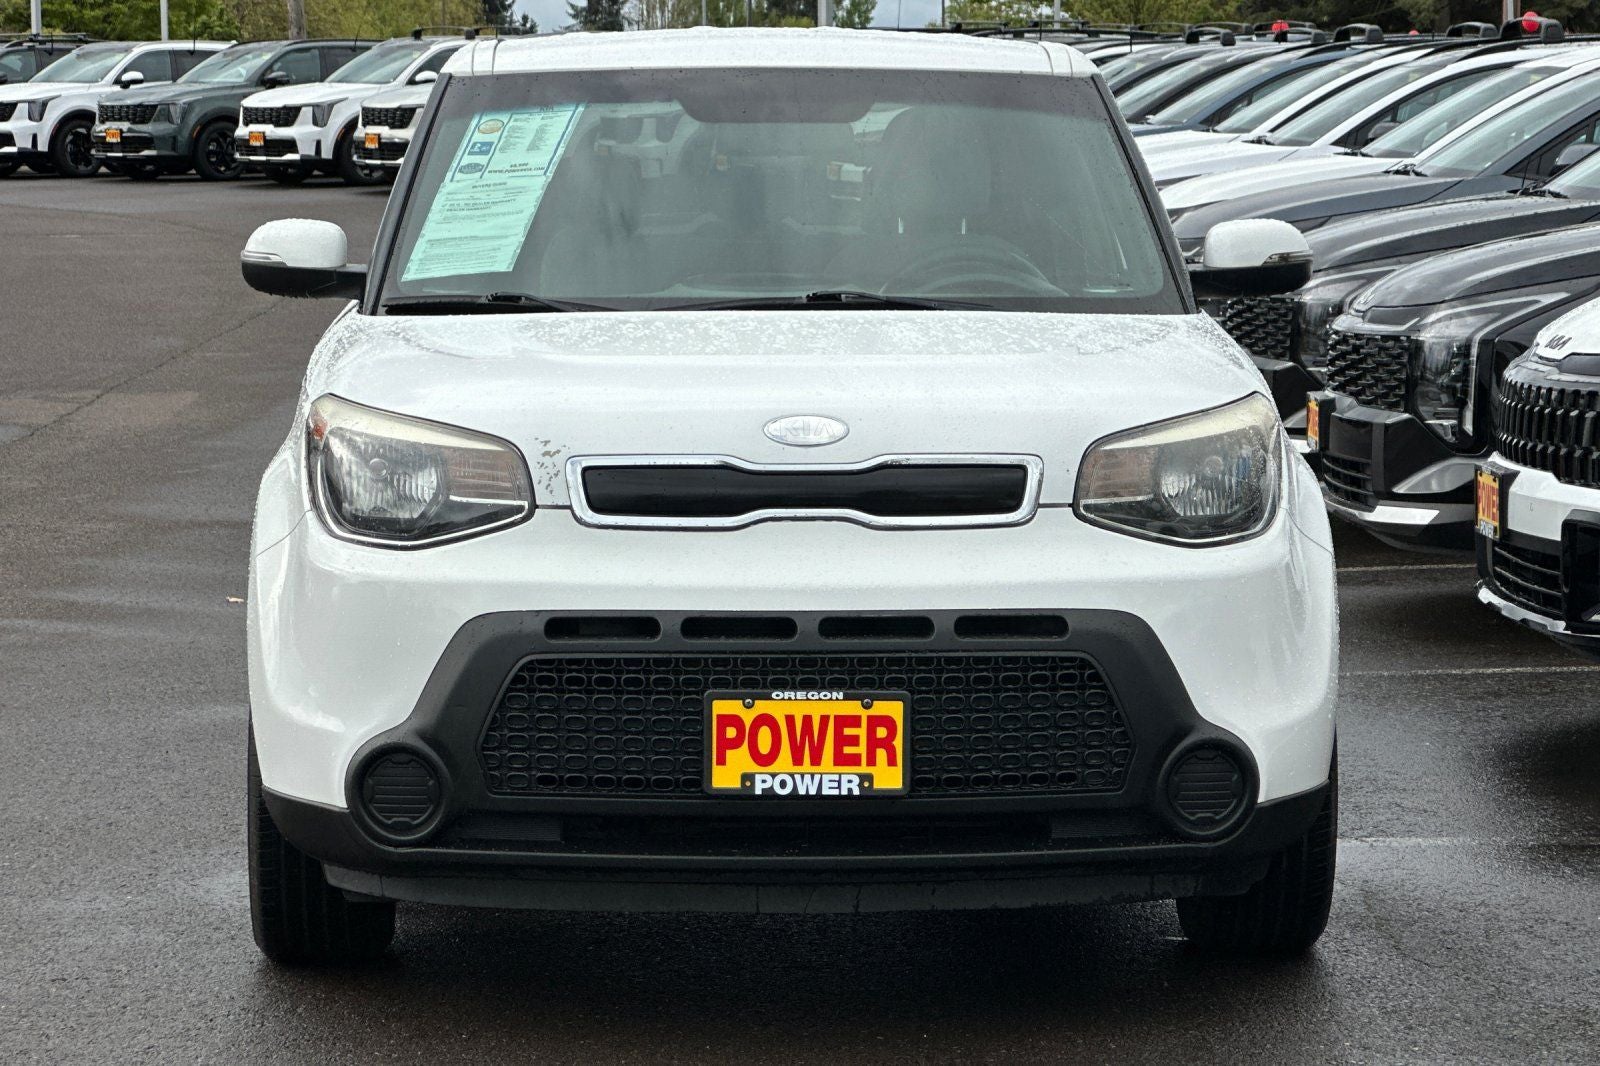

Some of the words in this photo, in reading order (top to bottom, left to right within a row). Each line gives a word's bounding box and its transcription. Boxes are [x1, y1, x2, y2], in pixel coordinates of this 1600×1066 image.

[771, 691, 844, 700] OREGON
[715, 713, 898, 767] POWER
[754, 773, 860, 796] POWER
